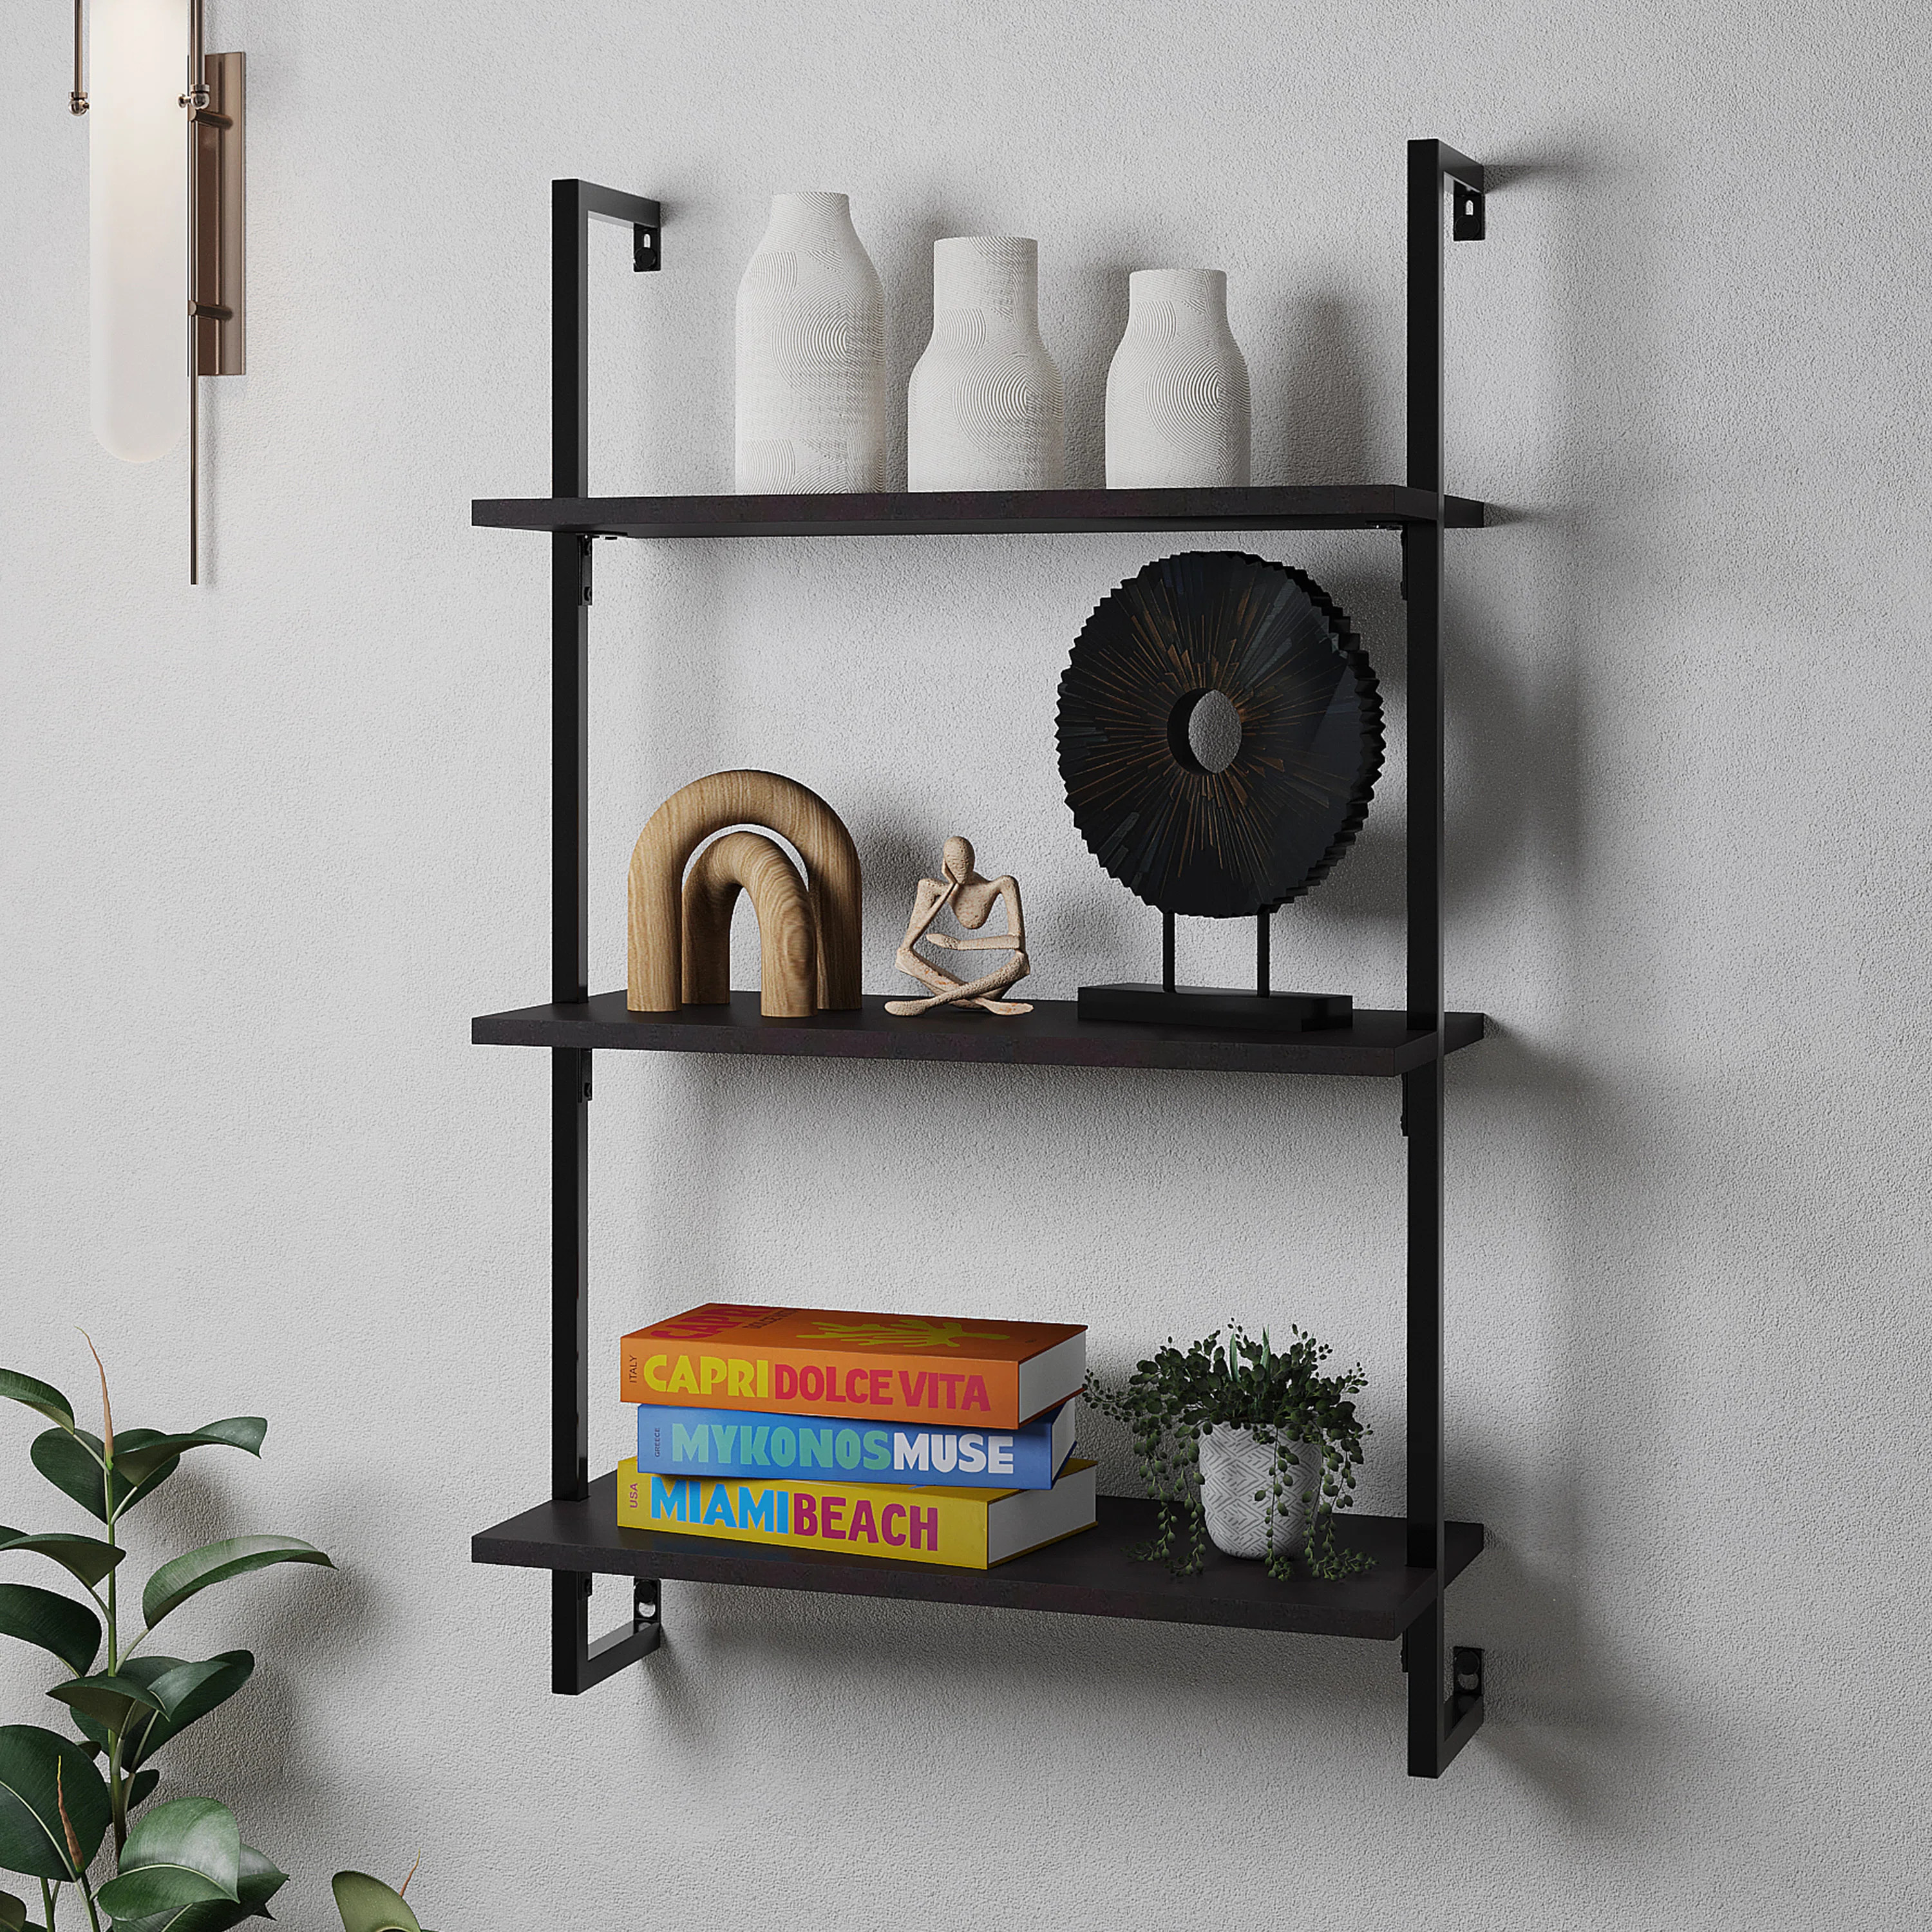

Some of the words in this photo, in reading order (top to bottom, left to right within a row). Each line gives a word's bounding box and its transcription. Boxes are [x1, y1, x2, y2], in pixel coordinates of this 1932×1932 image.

[629, 1355, 638, 1383] ITALY
[644, 1354, 768, 1398] CAPRI
[775, 1364, 893, 1405] DOLCE
[899, 1370, 991, 1412] VITA
[672, 1423, 891, 1471] MYKONOS
[894, 1433, 1014, 1474] MUSE
[630, 1482, 639, 1509] USA
[652, 1476, 789, 1535] MIAMI
[794, 1493, 938, 1551] BEACH
